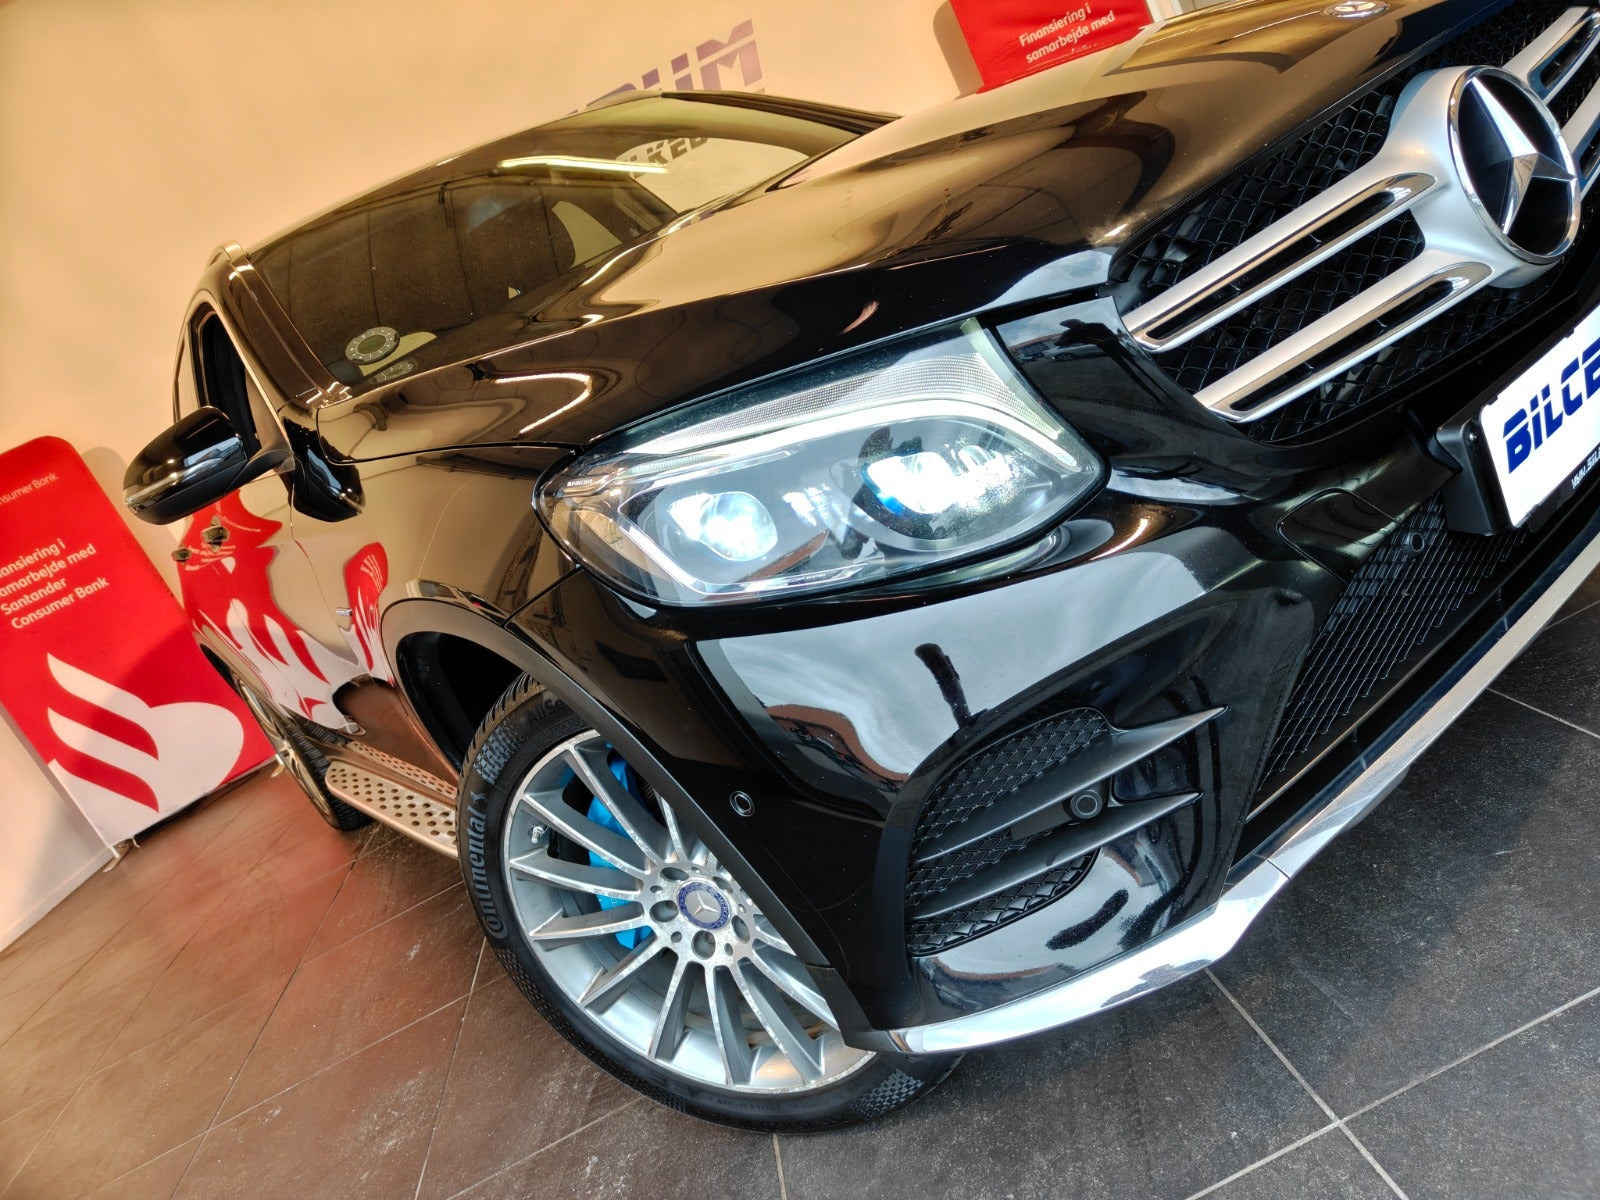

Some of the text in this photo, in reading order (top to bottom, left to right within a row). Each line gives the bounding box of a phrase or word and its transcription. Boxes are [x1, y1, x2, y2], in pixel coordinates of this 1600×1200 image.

[1019, 3, 1091, 47] Finansiering i
[1026, 10, 1115, 64] samarbejde med
[32, 472, 58, 490] Bank
[0, 538, 66, 579] ansiering i
[67, 543, 97, 565] med
[1, 577, 67, 615] Santander
[11, 577, 110, 629] Consumer Bank
